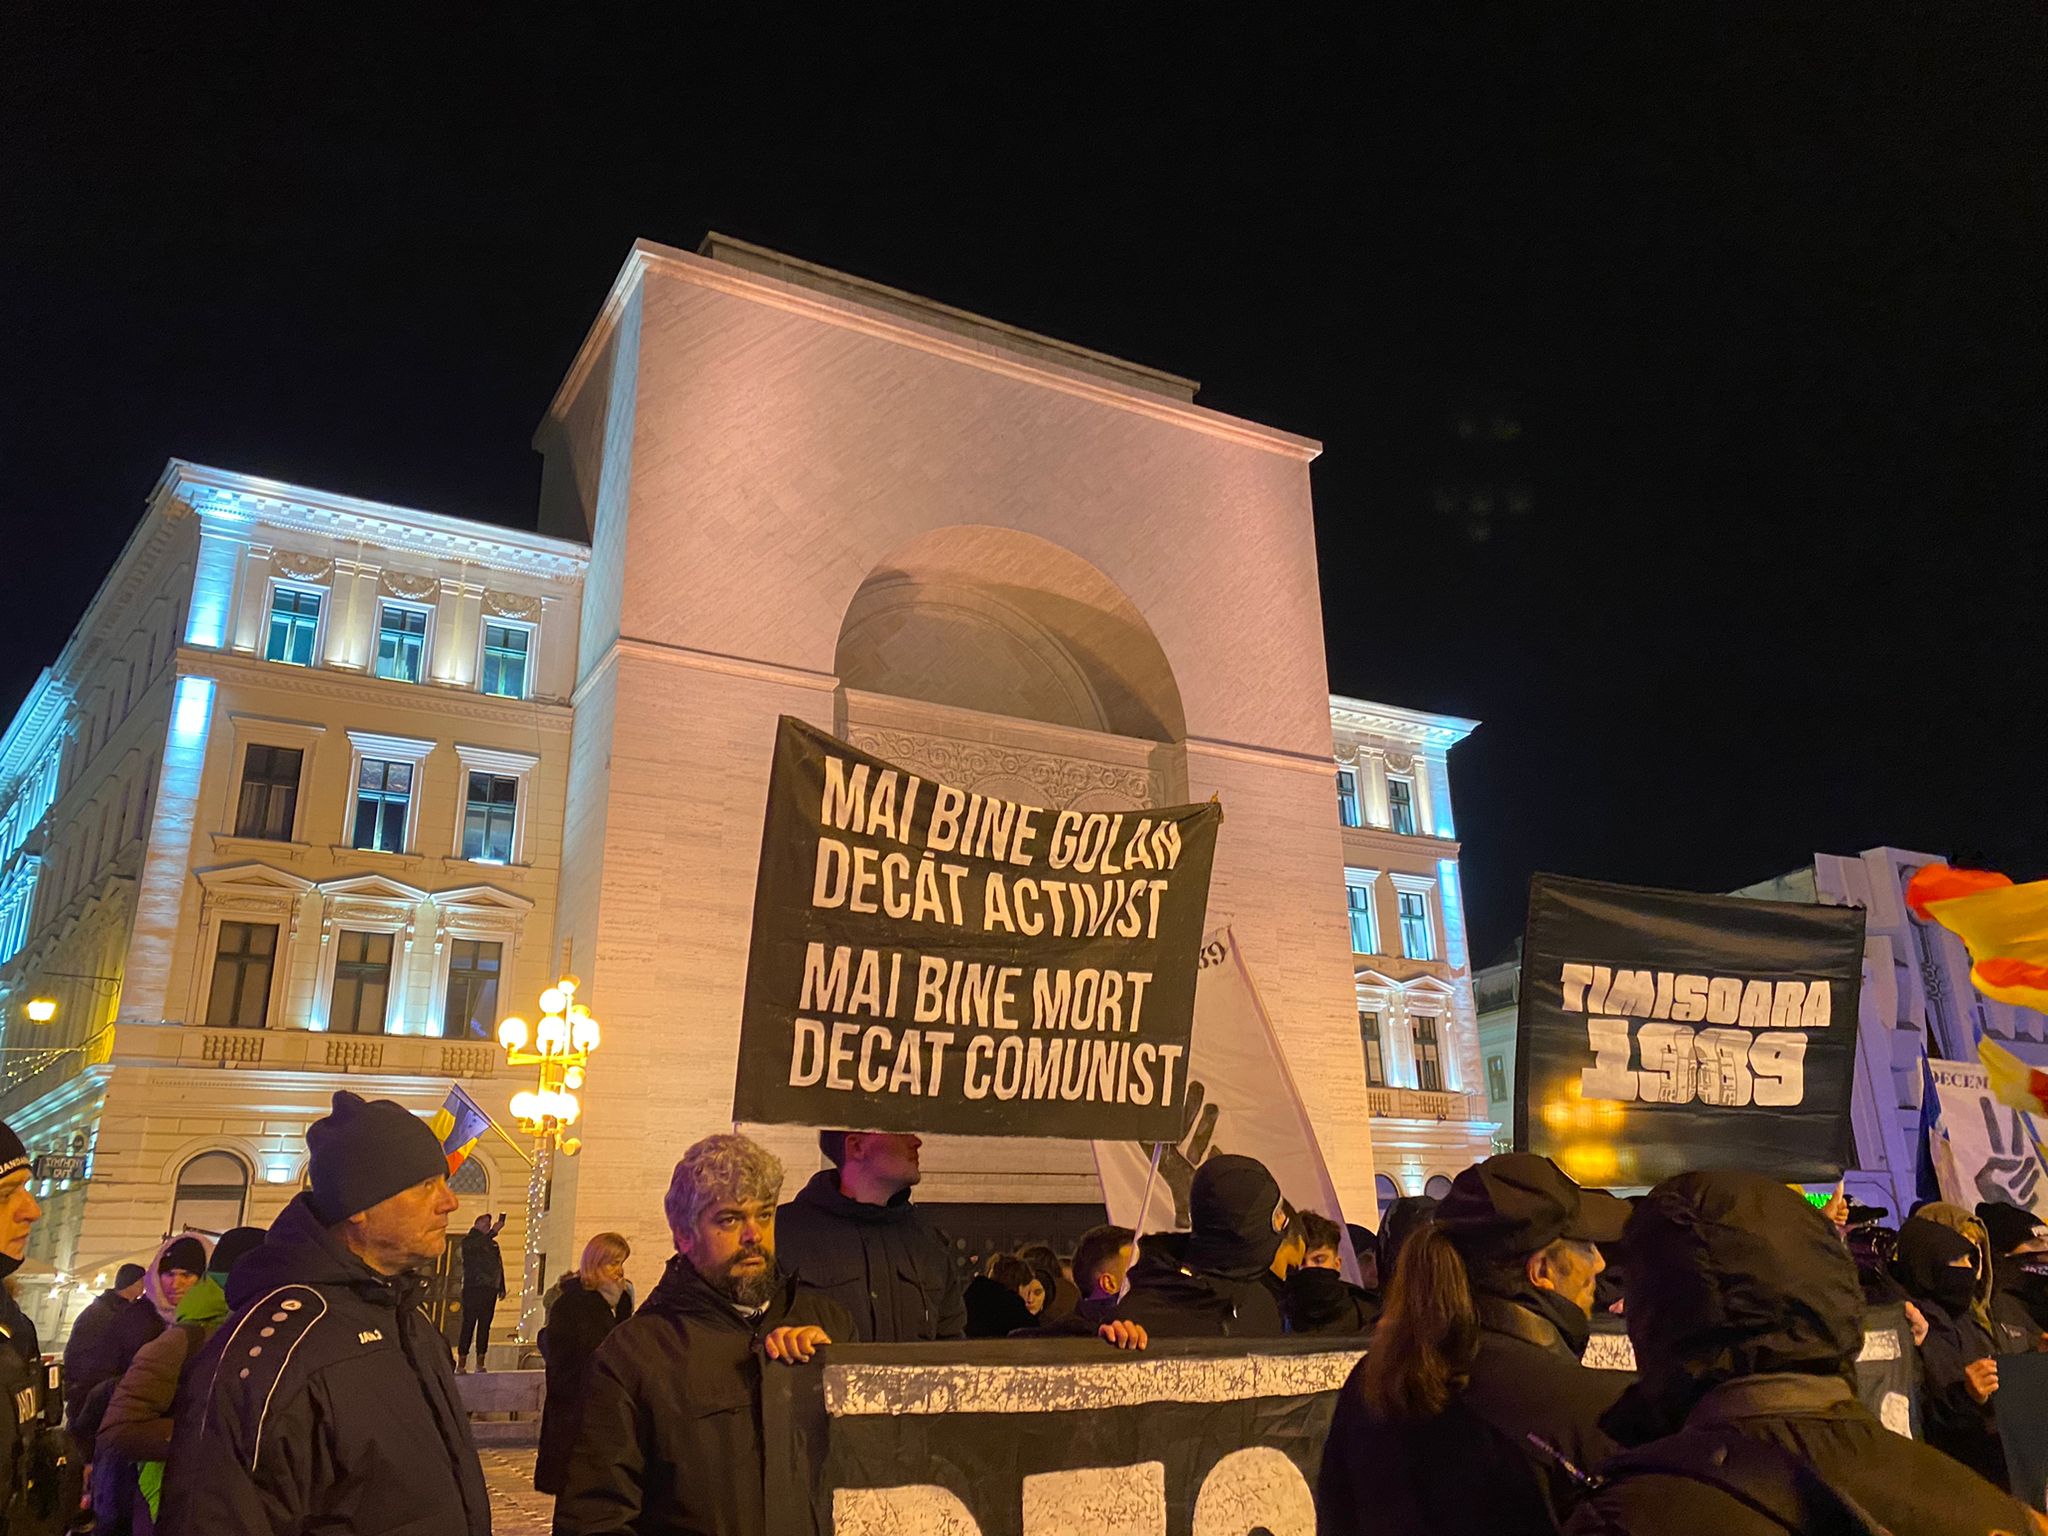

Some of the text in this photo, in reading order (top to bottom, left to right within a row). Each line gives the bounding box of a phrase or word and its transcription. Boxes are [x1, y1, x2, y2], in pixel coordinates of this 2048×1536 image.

[821, 755, 1182, 875] MAI BINE GOLAN
[983, 872, 1168, 939] ACTIVIST
[799, 942, 1152, 1033] MAI BINE MORT
[1561, 963, 1832, 1027] TIMISOARA
[964, 1035, 1183, 1107] COMUNIST
[1581, 1018, 1808, 1106] 1989
